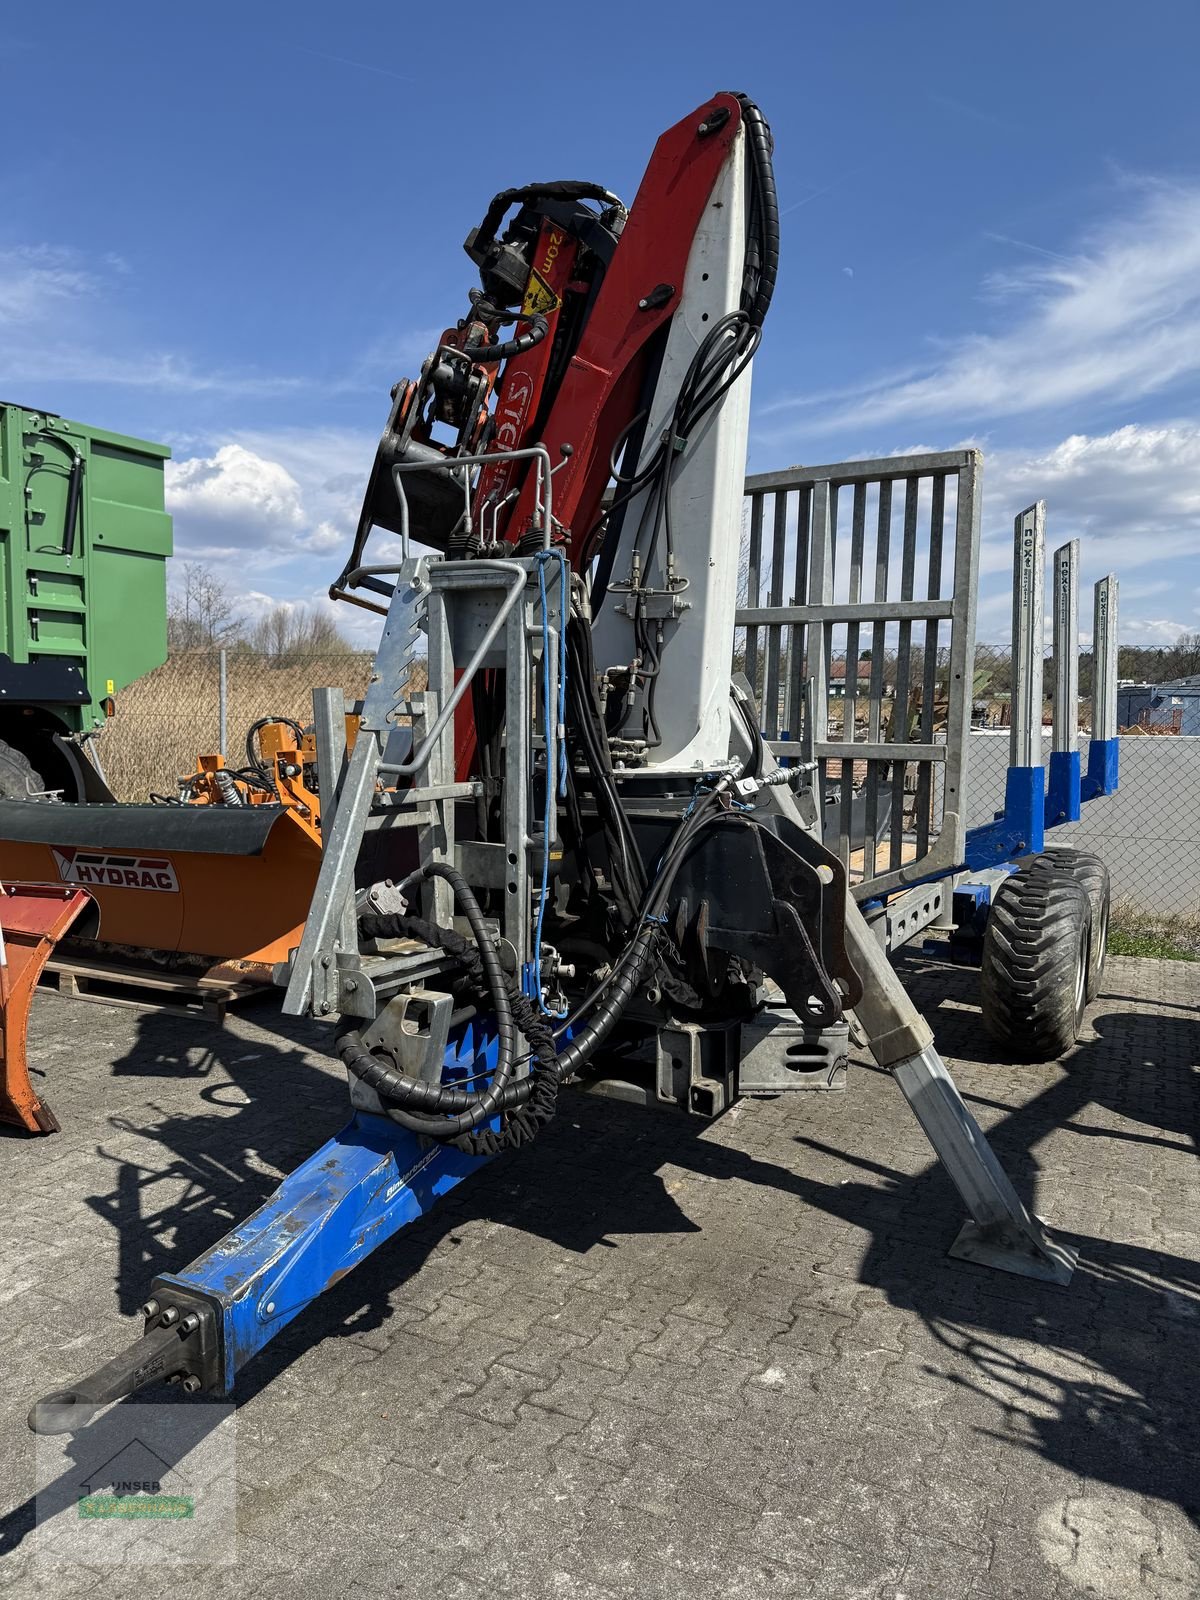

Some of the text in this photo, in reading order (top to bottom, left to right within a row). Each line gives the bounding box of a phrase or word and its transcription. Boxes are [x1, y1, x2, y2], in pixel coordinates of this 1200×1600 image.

[1023, 528, 1033, 568] next
[76, 865, 173, 889] HYDRAC
[386, 1145, 440, 1197] Binderberger
